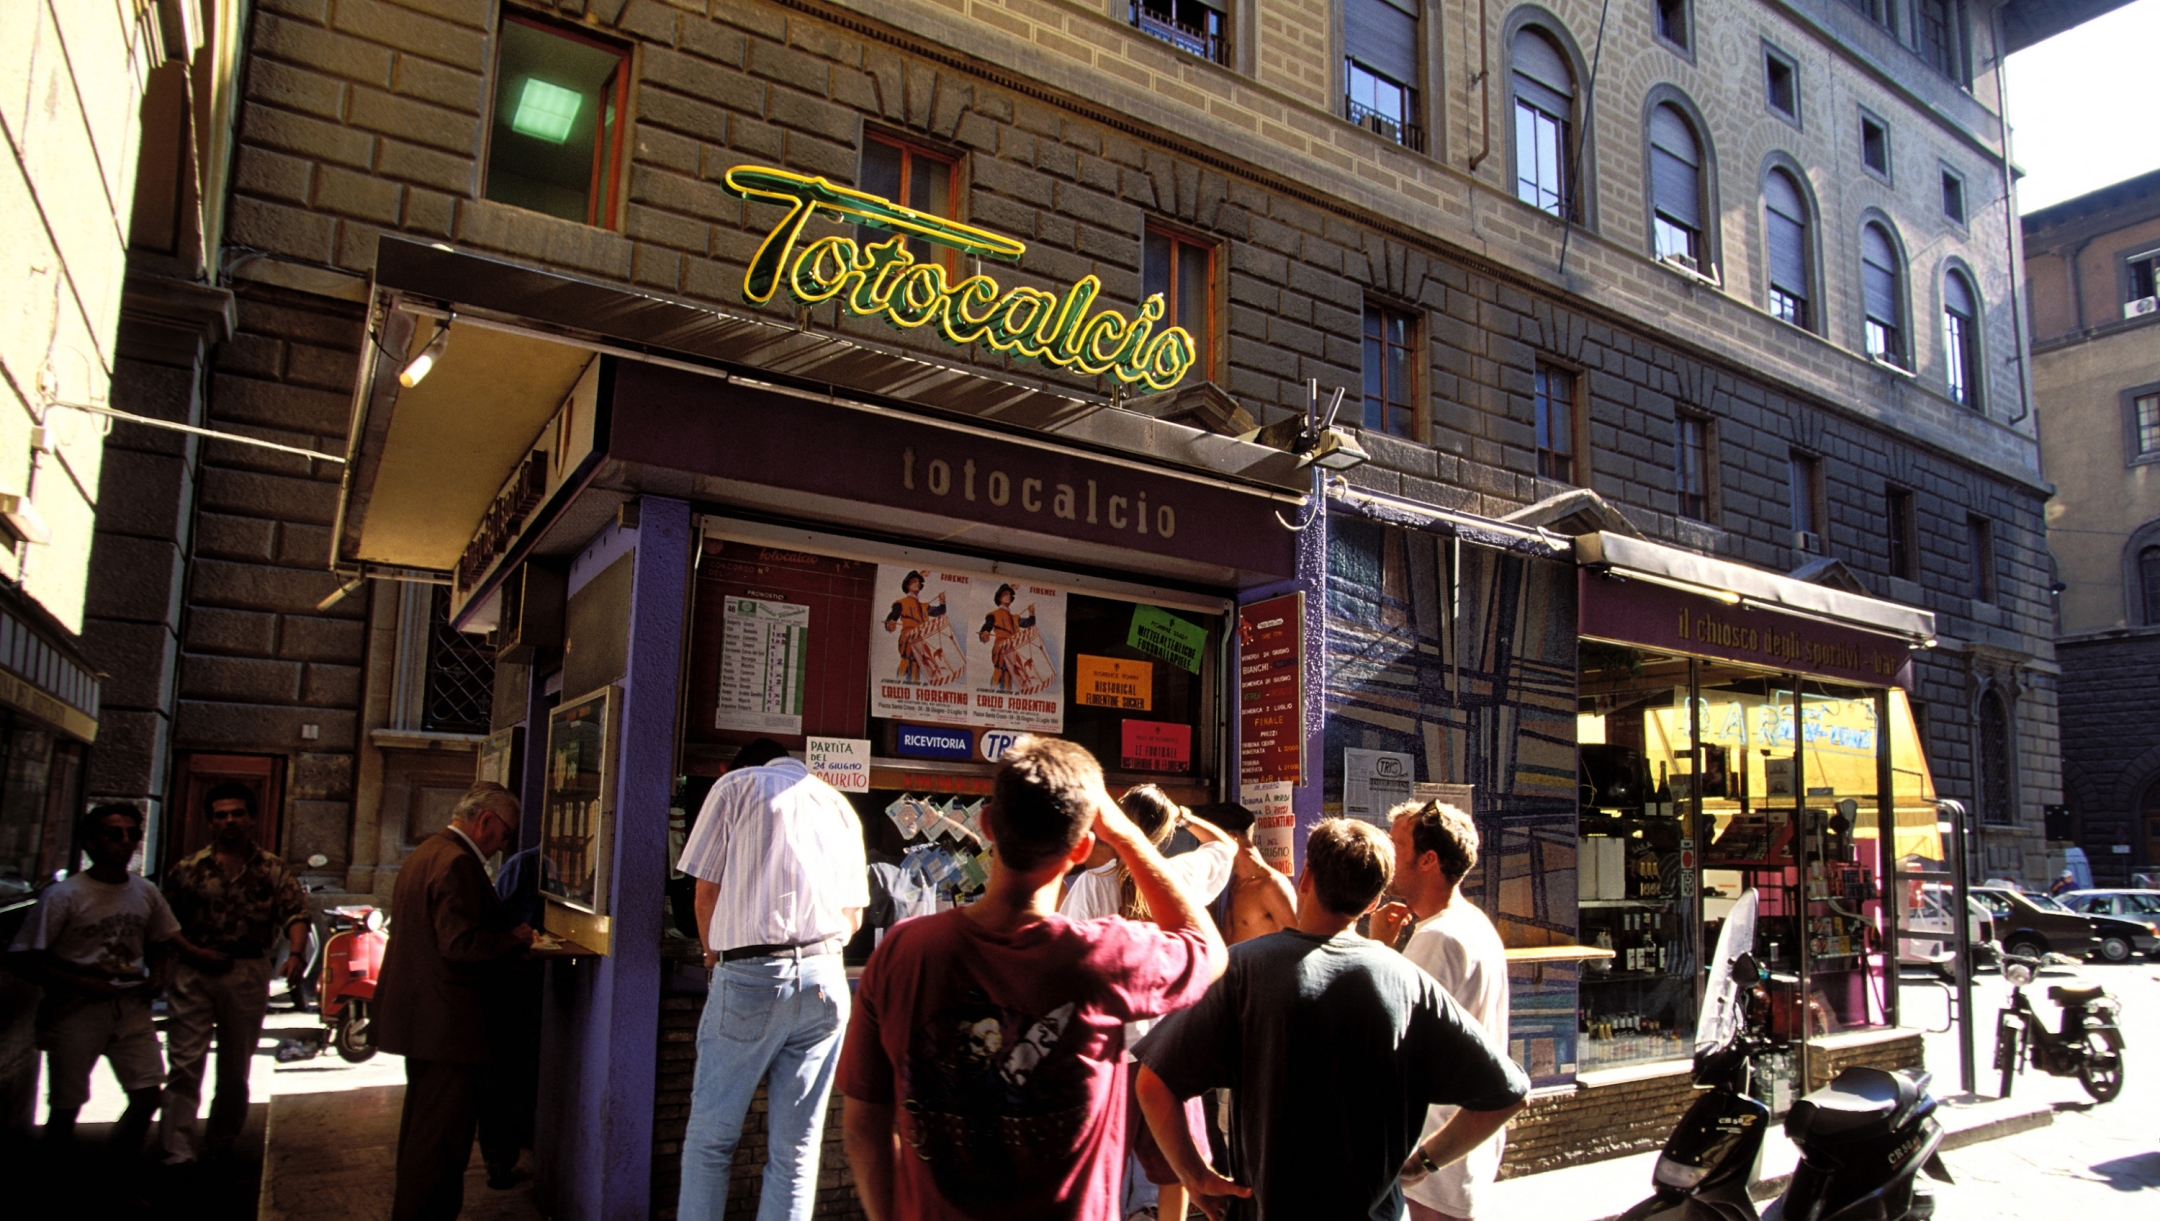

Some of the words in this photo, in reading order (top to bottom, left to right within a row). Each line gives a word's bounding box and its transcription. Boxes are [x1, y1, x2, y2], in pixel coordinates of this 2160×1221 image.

[721, 165, 1196, 392] Totocalcio
[902, 445, 1176, 539] totocalcio
[709, 561, 755, 574] CONCORSO
[940, 573, 969, 585] FIRENZE
[746, 590, 785, 600] PRONOSTICI
[1029, 586, 1056, 597] FIRENZE
[1137, 624, 1196, 660] MITTELALTERLICHE
[1678, 608, 1691, 639] il
[1696, 613, 1759, 652] chiosco
[1763, 626, 1802, 664] degli
[1805, 640, 1860, 669] sportivi
[1874, 649, 1898, 676] bar
[1137, 638, 1191, 670] FUSSBALLSPIELE
[1095, 680, 1137, 696] HISTORICAL
[881, 685, 911, 700] CALCIO
[915, 688, 968, 706] FIORENTINO
[1086, 693, 1119, 707] FLORENTINE
[976, 695, 1004, 709] CALCIO
[1008, 698, 1057, 714] FIORENTINO
[1241, 707, 1263, 715] DOMENICA
[1274, 703, 1292, 712] LUGLIO
[1254, 716, 1284, 727] FINALE
[1683, 697, 1781, 747] BAR
[904, 734, 966, 750] RICEVITORIA
[1135, 744, 1143, 756] LE
[1145, 746, 1177, 759] FOOTBALL
[813, 761, 825, 770] 24
[1154, 759, 1160, 769] DE
[1265, 793, 1270, 802] A
[1265, 805, 1271, 815] B
[1257, 816, 1295, 829] FIORENTINO
[1267, 838, 1278, 846] DEL
[1888, 1148, 1904, 1164] CR
